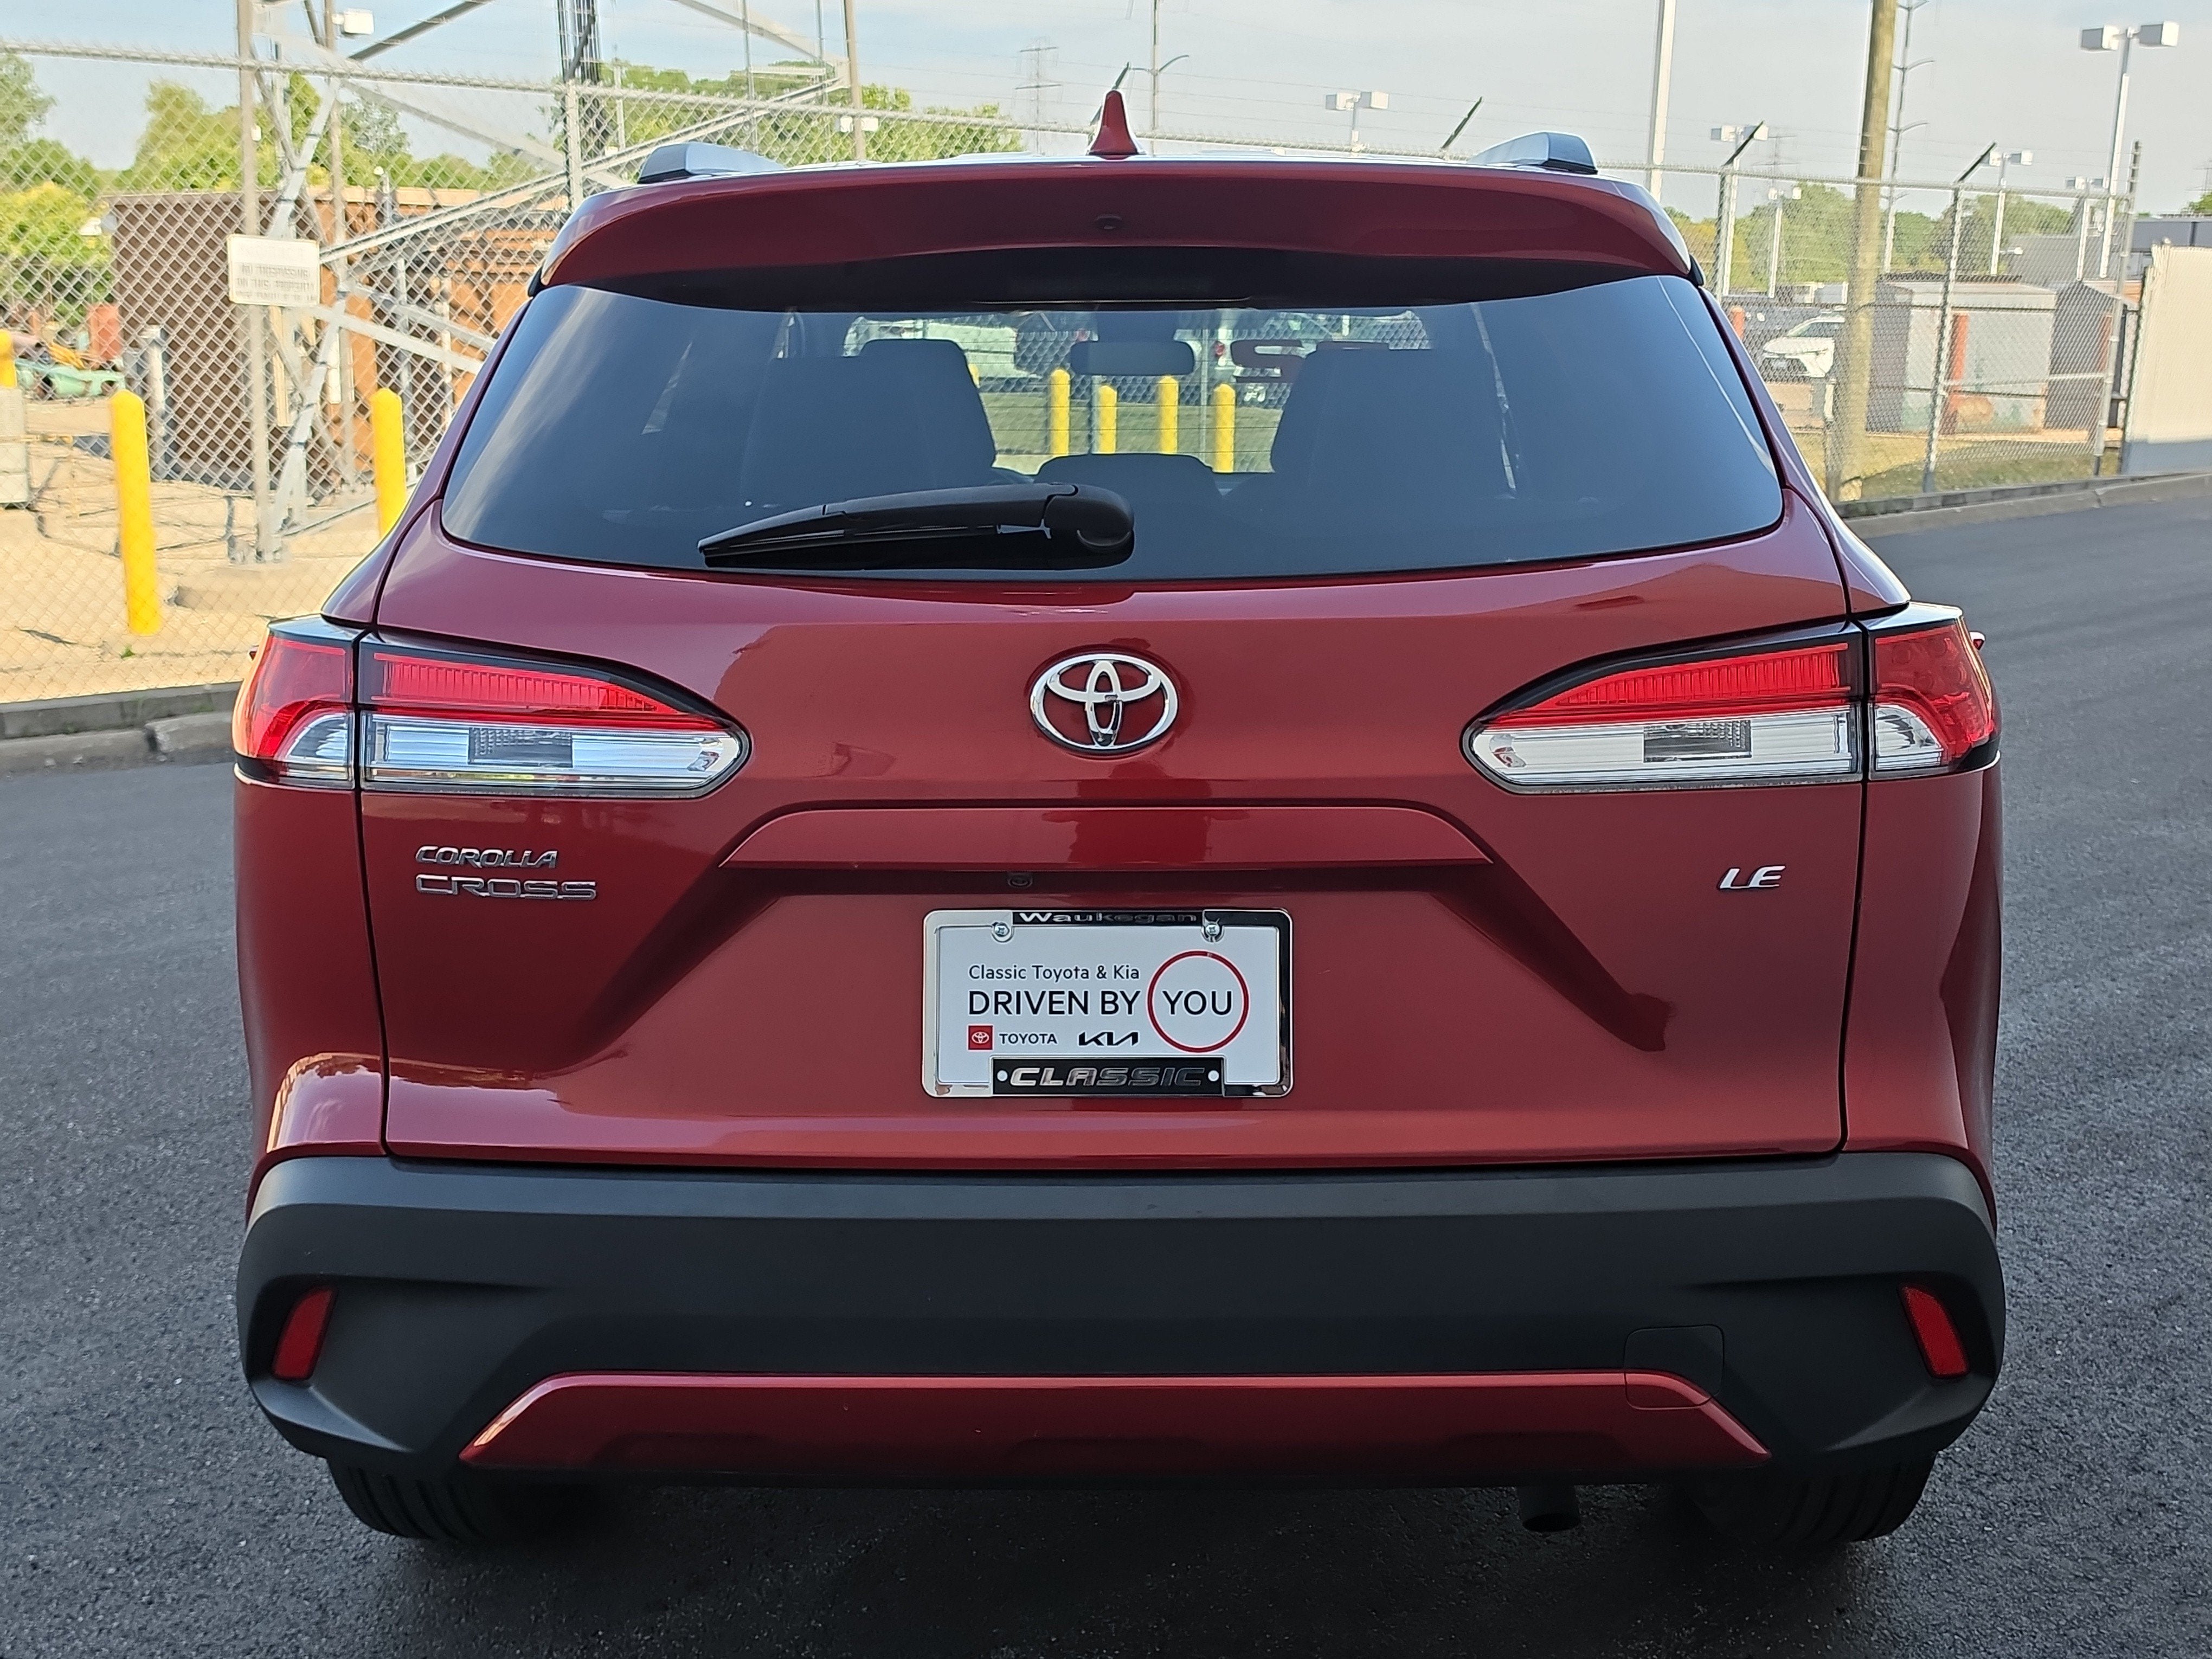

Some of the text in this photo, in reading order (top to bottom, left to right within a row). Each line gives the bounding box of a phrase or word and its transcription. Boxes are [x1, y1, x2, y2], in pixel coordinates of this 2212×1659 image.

[416, 846, 558, 868] COROLLA
[415, 873, 597, 901] CROSS
[1719, 865, 1786, 889] LE
[1019, 912, 1197, 923] Waukegan
[969, 964, 1140, 983] Classic Toyota & Kia
[968, 990, 1232, 1016] DRIVEN BY YOU
[999, 1033, 1058, 1044] TOYOTA
[1009, 1067, 1205, 1086] CLASSIC
